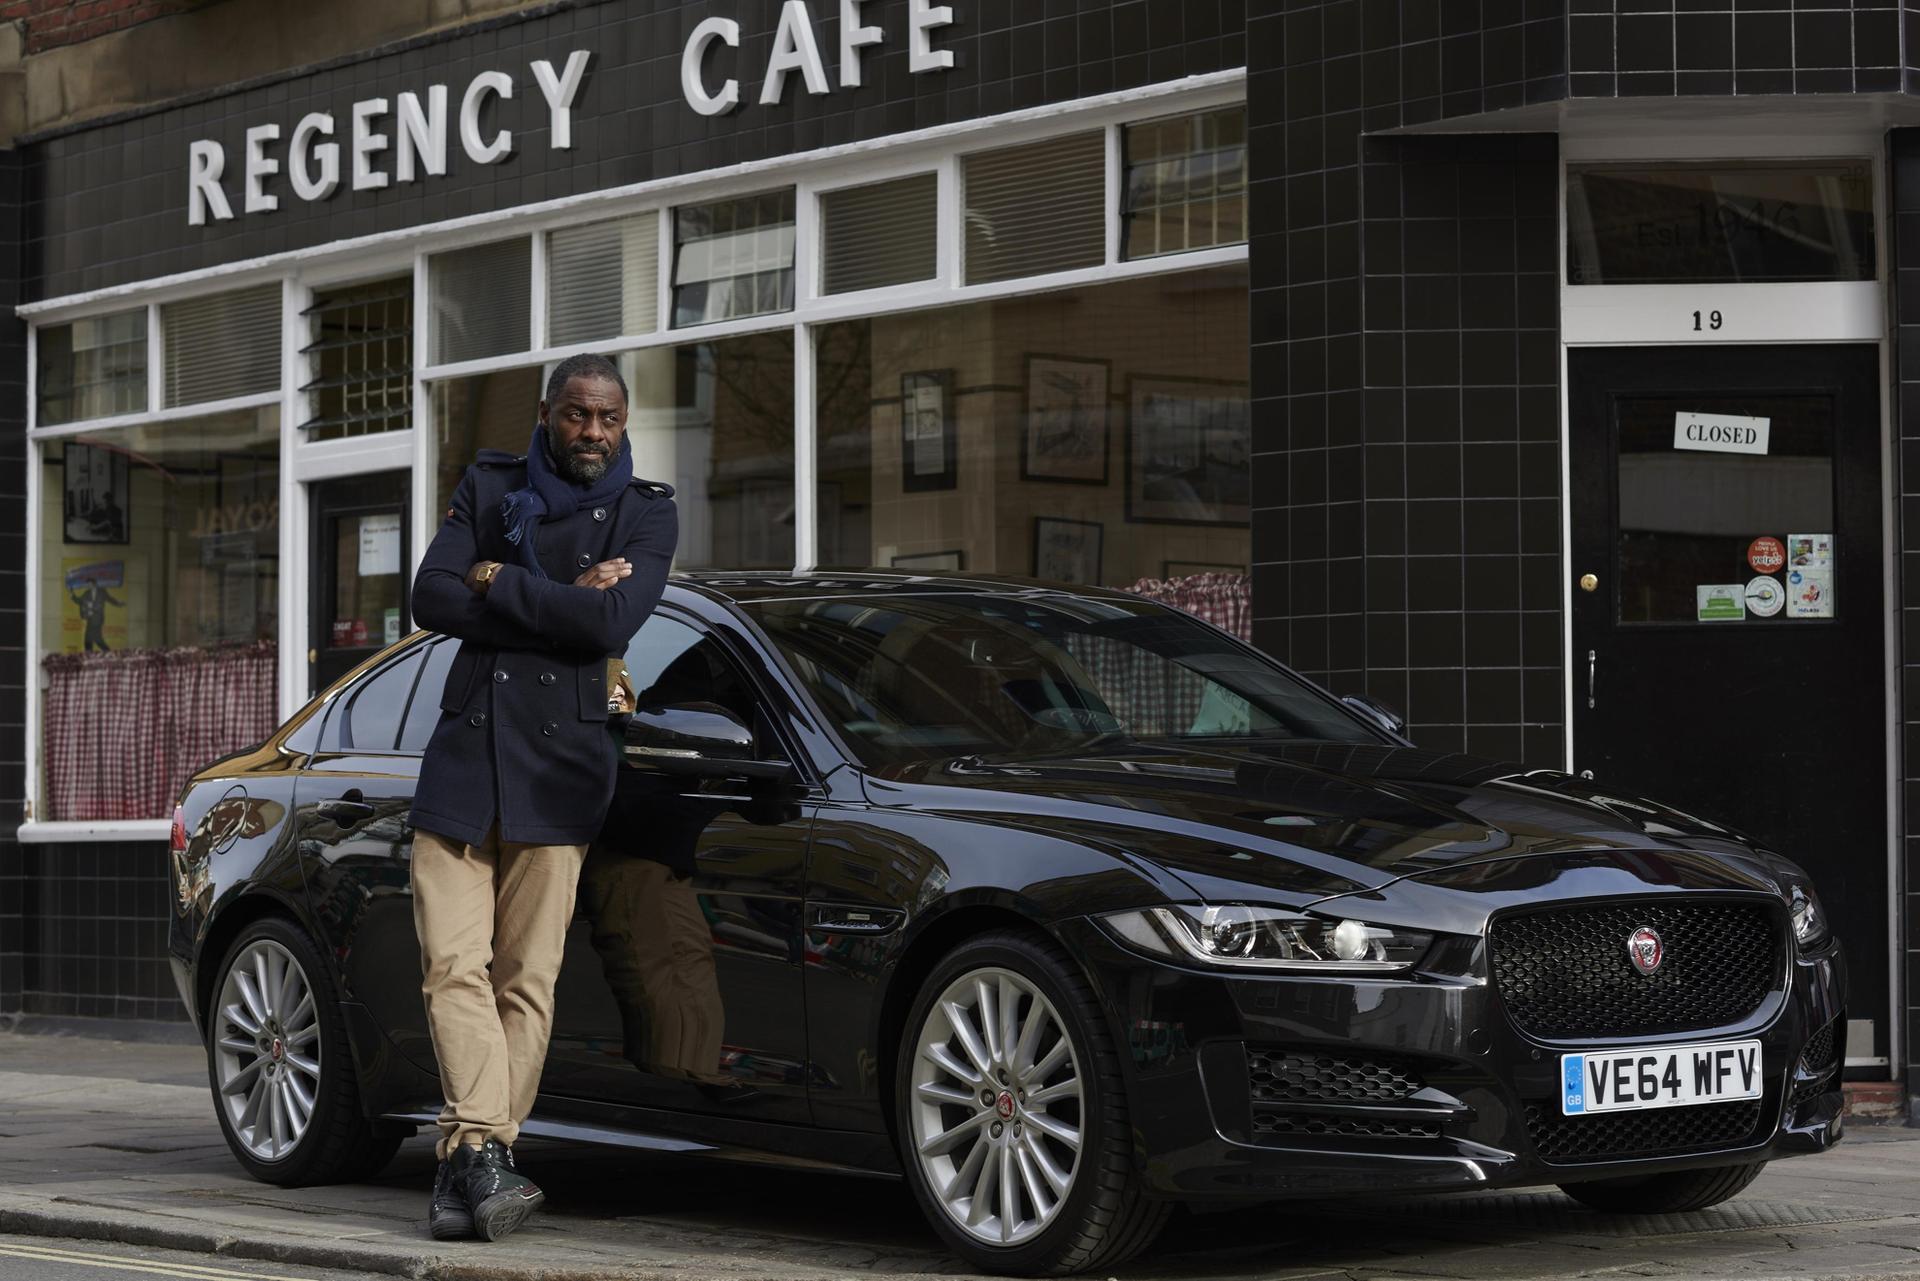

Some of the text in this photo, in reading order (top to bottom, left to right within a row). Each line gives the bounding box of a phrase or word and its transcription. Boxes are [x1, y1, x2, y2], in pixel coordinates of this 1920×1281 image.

[188, 0, 954, 226] REGENCY CAFE
[1695, 200, 1801, 243] 1946
[1693, 310, 1723, 331] 19
[1686, 424, 1757, 445] CLOSED
[1588, 1048, 1756, 1105] VE64 WFV
[1567, 1094, 1582, 1106] GB
